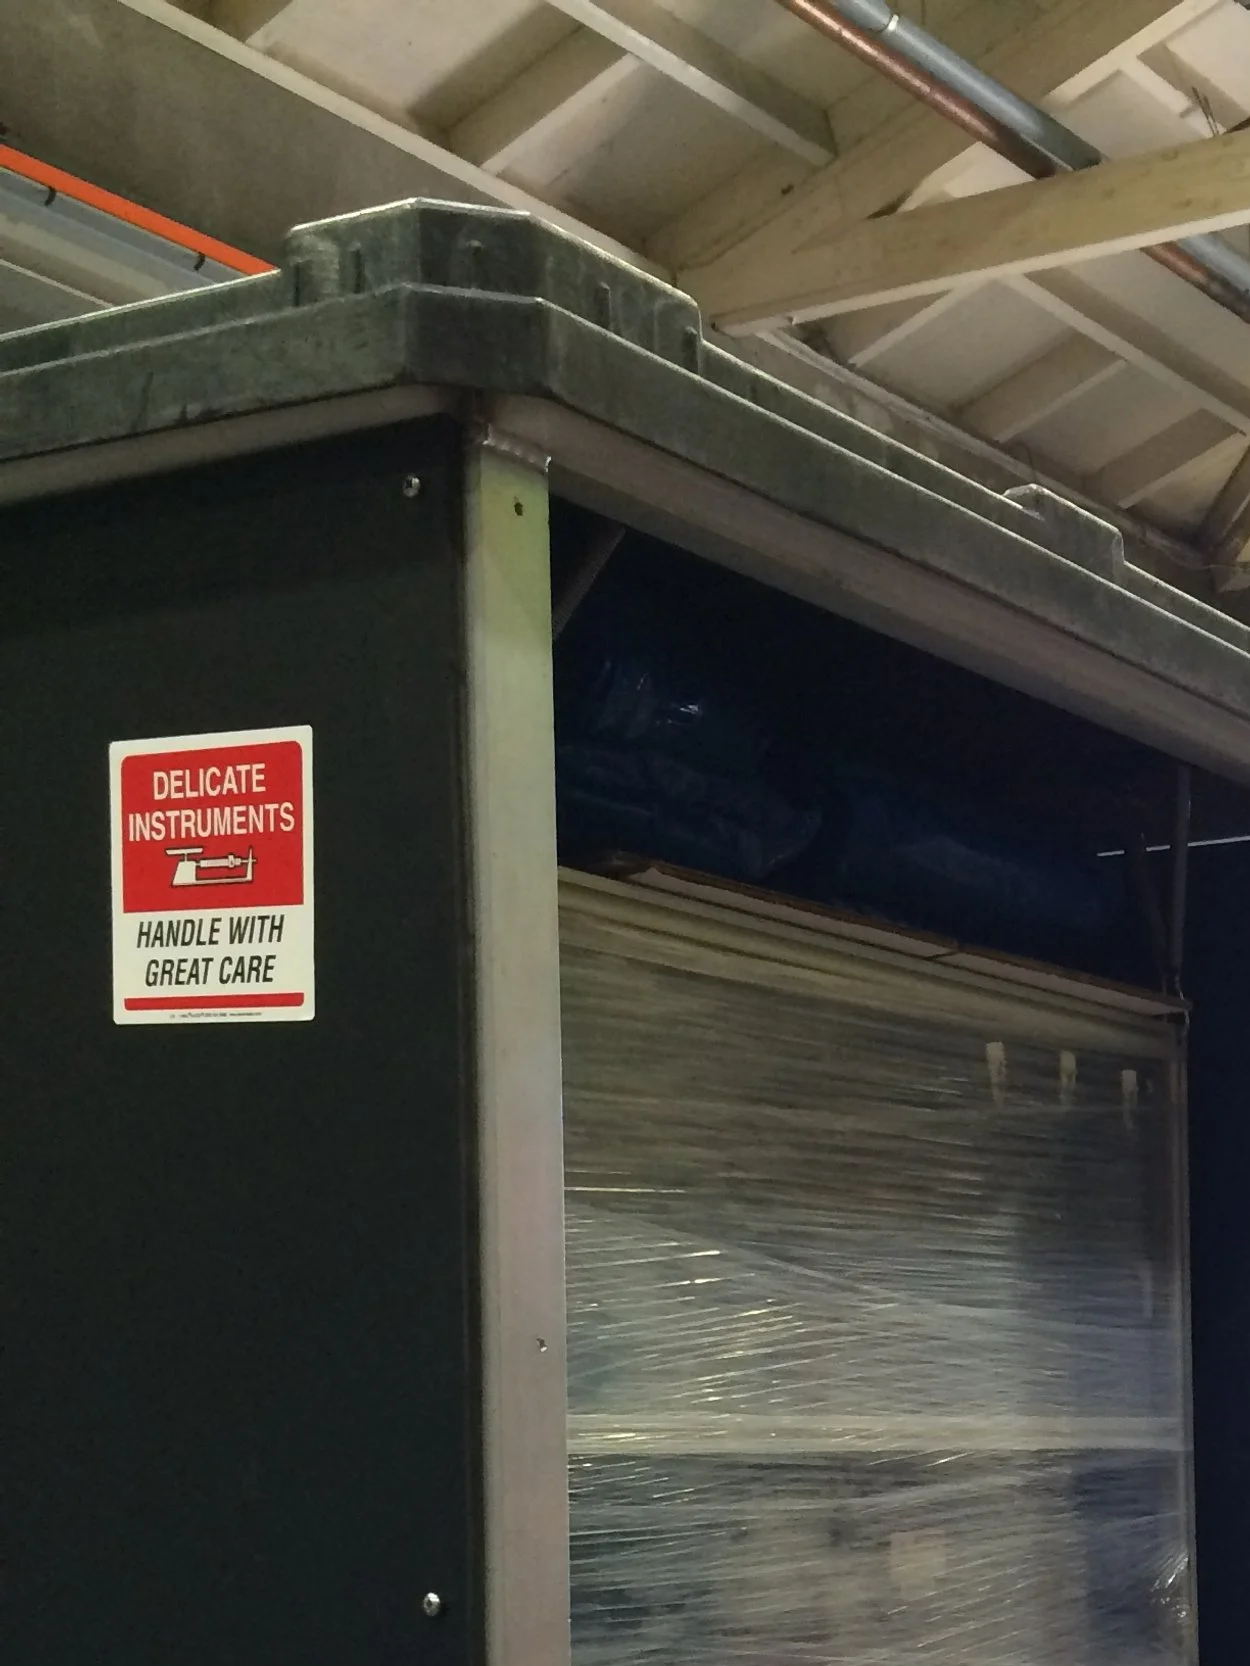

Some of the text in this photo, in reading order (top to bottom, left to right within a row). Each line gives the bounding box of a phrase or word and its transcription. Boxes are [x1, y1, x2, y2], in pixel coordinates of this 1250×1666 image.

[153, 763, 267, 801] DELICATE
[128, 802, 295, 842] INSTRUMENTS
[136, 914, 285, 949] HANDLE WITH
[145, 954, 276, 987] GREAT CARE
